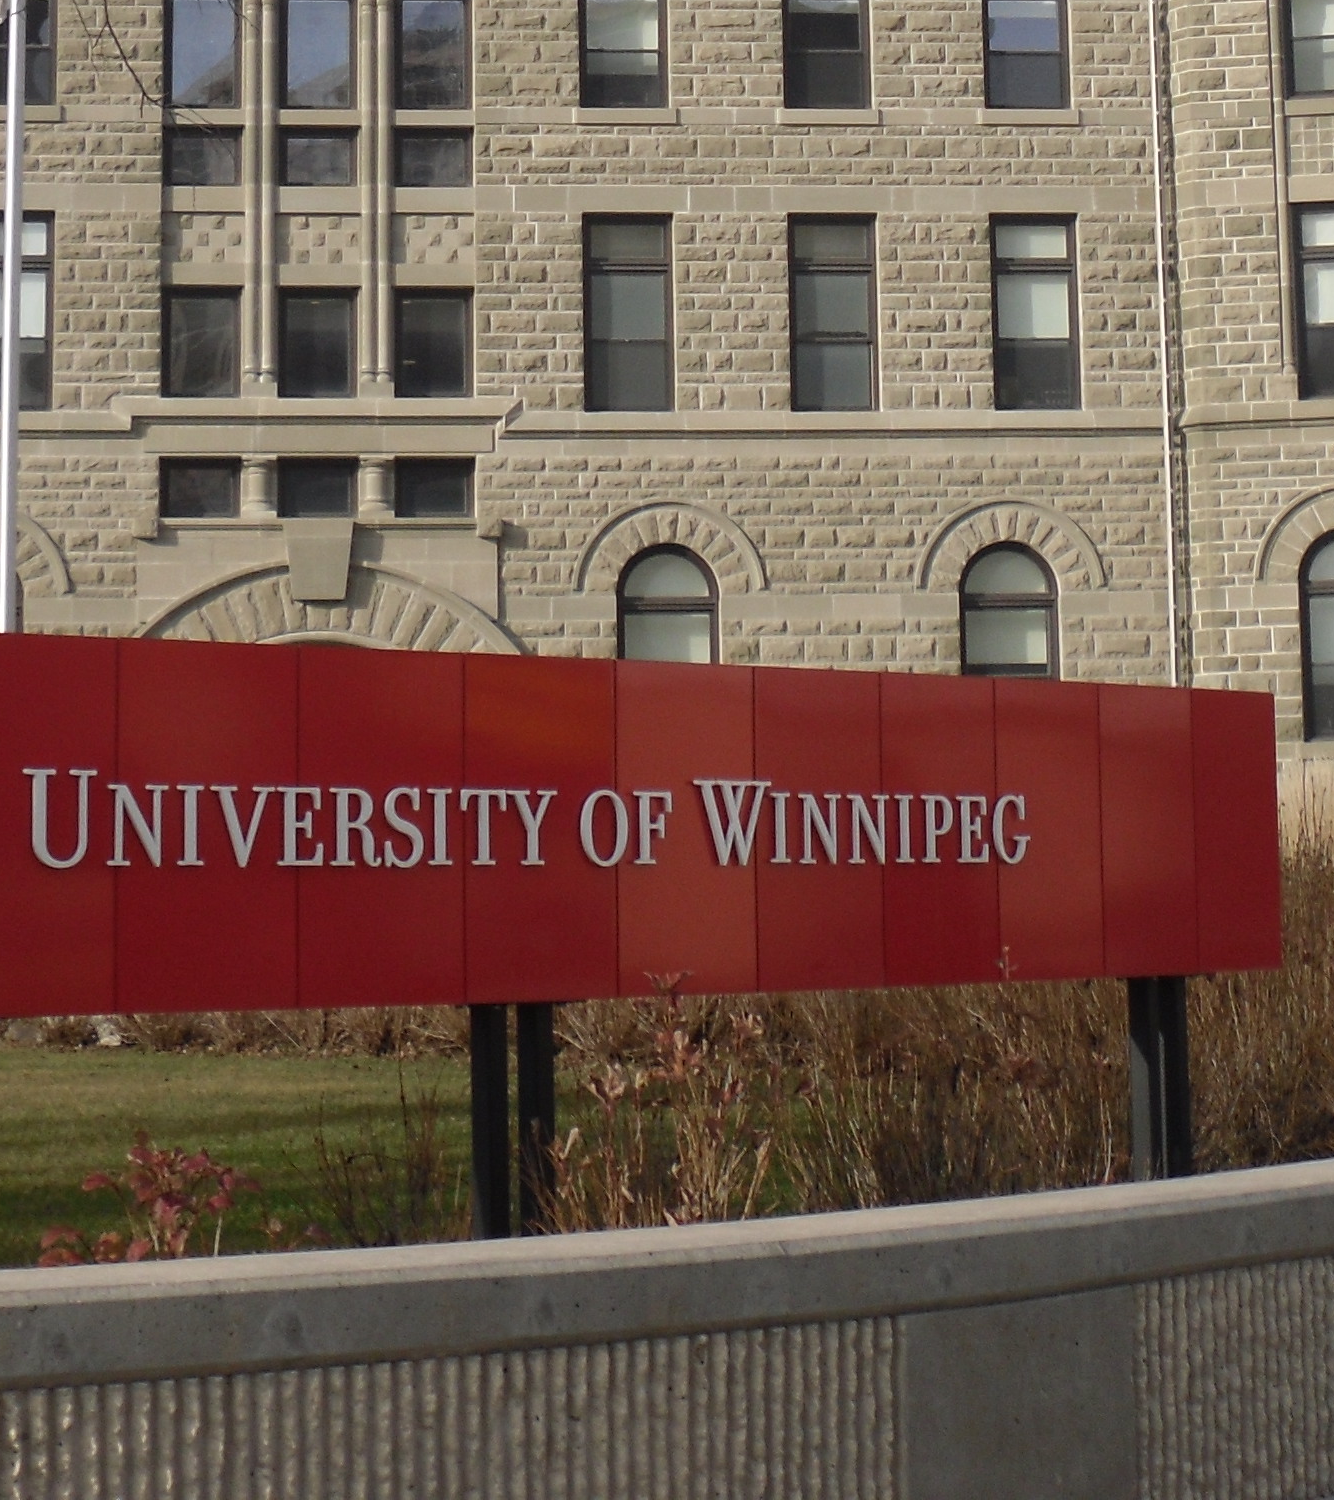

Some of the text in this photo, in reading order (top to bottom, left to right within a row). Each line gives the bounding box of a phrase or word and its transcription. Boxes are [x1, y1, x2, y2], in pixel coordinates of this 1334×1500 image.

[22, 768, 558, 869] UNIVERSITY
[580, 789, 673, 867] OF
[692, 778, 1031, 867] WINNIPEG
